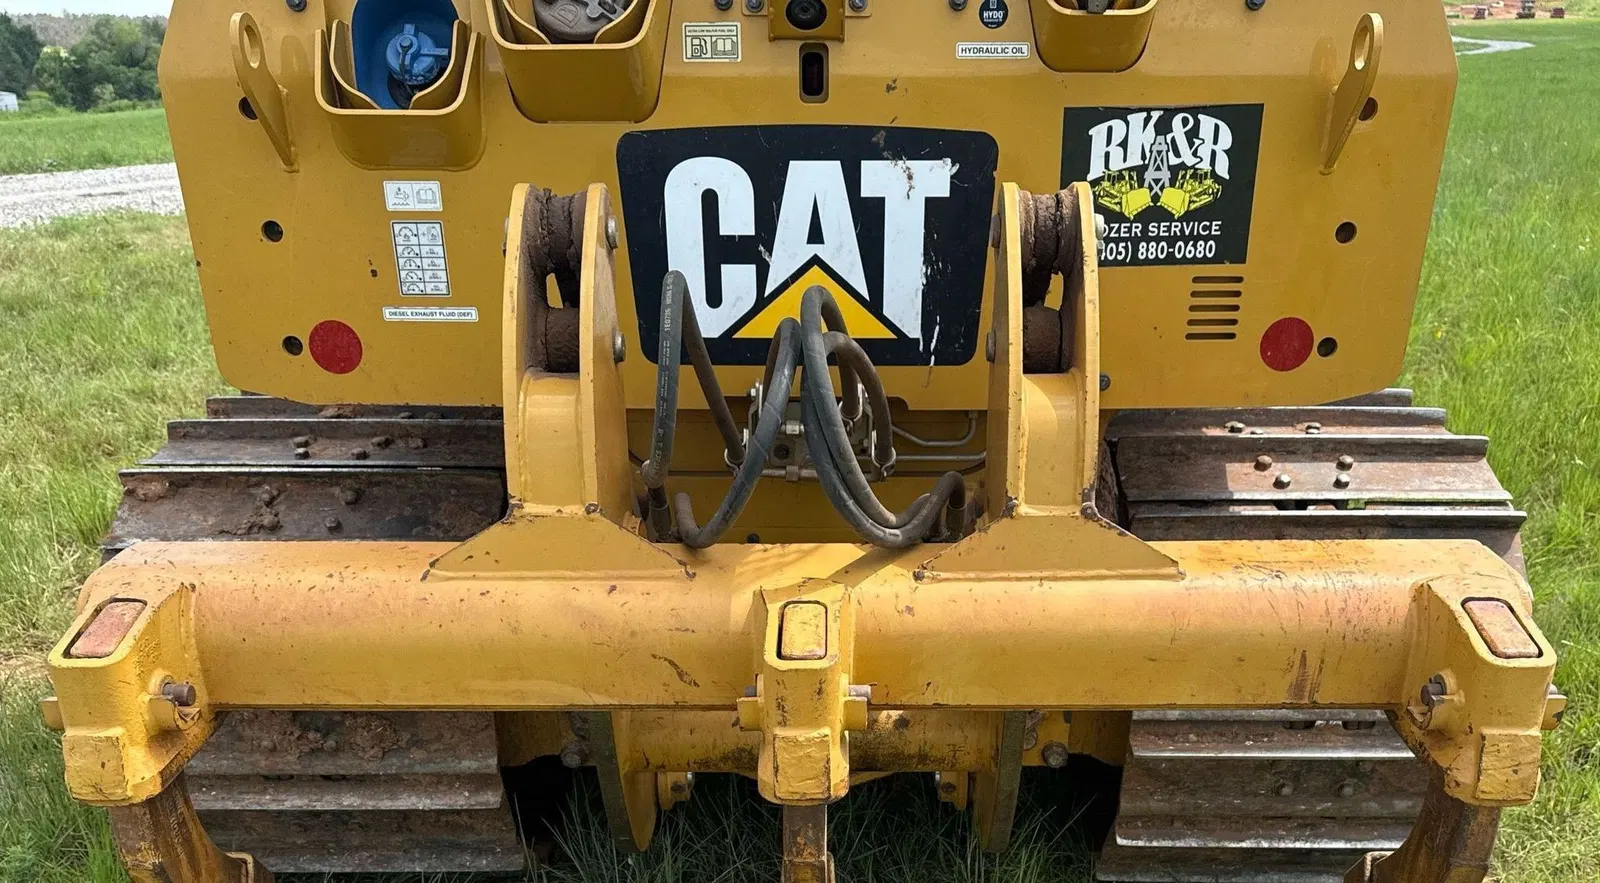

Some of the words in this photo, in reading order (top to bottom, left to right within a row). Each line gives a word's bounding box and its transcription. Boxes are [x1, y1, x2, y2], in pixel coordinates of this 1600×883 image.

[983, 10, 1004, 19] HYDO
[960, 46, 1010, 55] HYDRAULIC
[1011, 46, 1025, 55] OIL
[1086, 110, 1233, 181] RK&R
[1102, 223, 1142, 238] ZER
[1148, 221, 1222, 237] SERVICE
[664, 156, 951, 338] CAT
[1101, 240, 1132, 263] 05)
[1138, 240, 1216, 260] 880-0680
